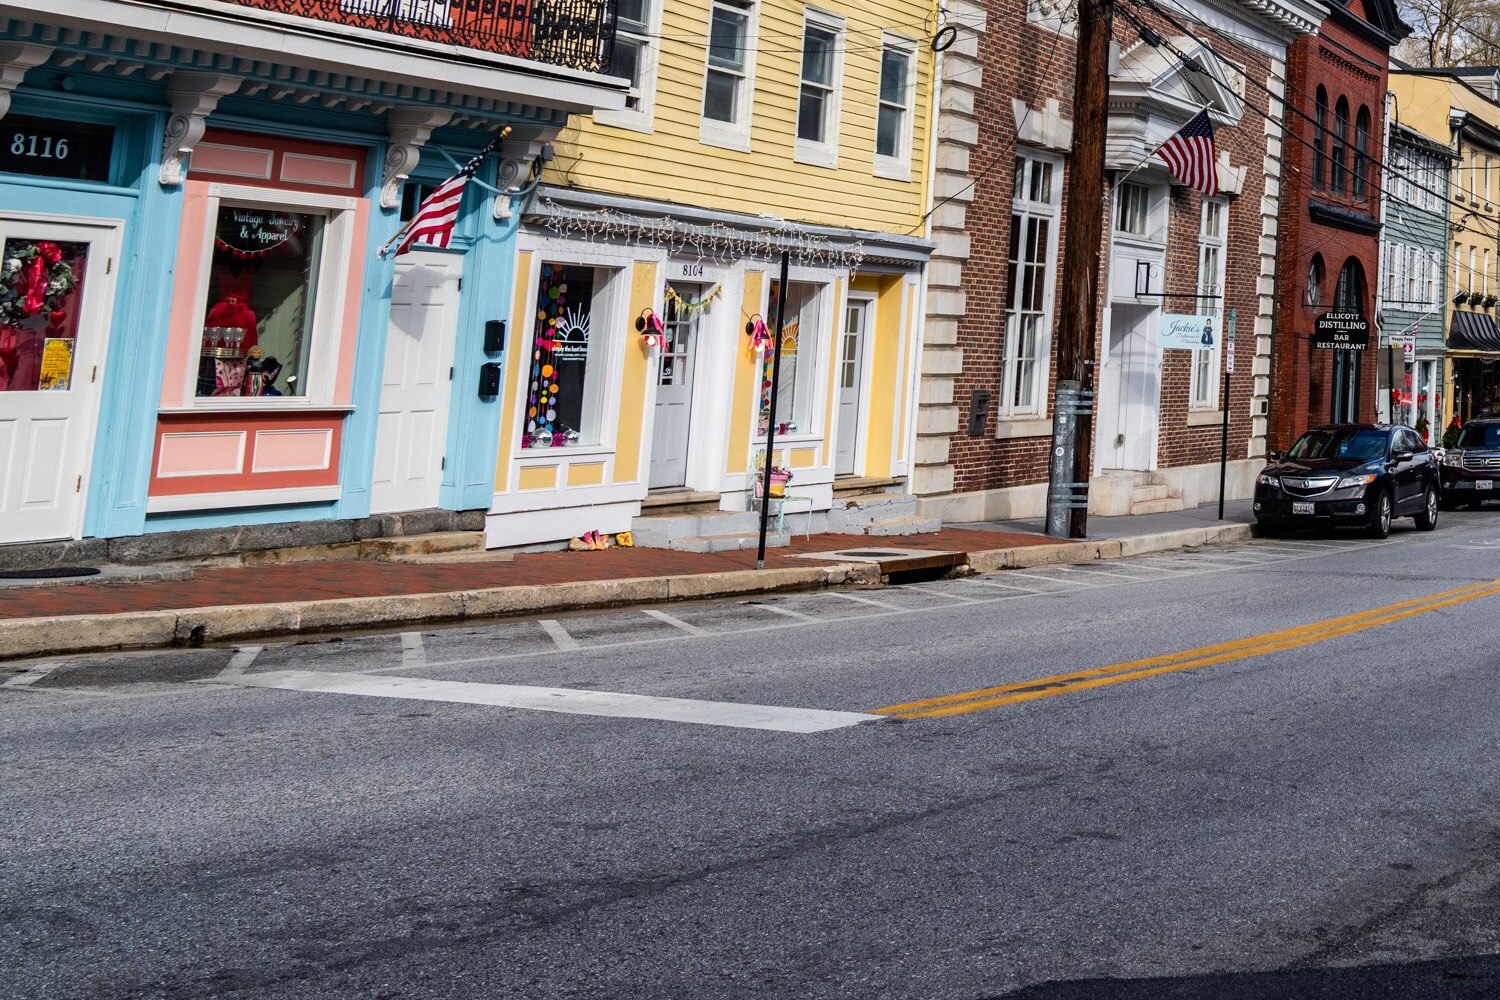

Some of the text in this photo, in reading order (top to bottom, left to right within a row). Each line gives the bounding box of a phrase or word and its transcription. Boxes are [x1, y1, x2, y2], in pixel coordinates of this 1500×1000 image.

[10, 133, 69, 160] 8116
[232, 210, 299, 232] Vintage Jewelry
[240, 224, 288, 244] & Apparel
[683, 264, 703, 277] 8104
[1326, 312, 1359, 320] ELLICOTT
[1161, 319, 1200, 337] Jackie's
[1319, 320, 1366, 330] DISTILLING
[1316, 341, 1366, 350] RESTAURANT
